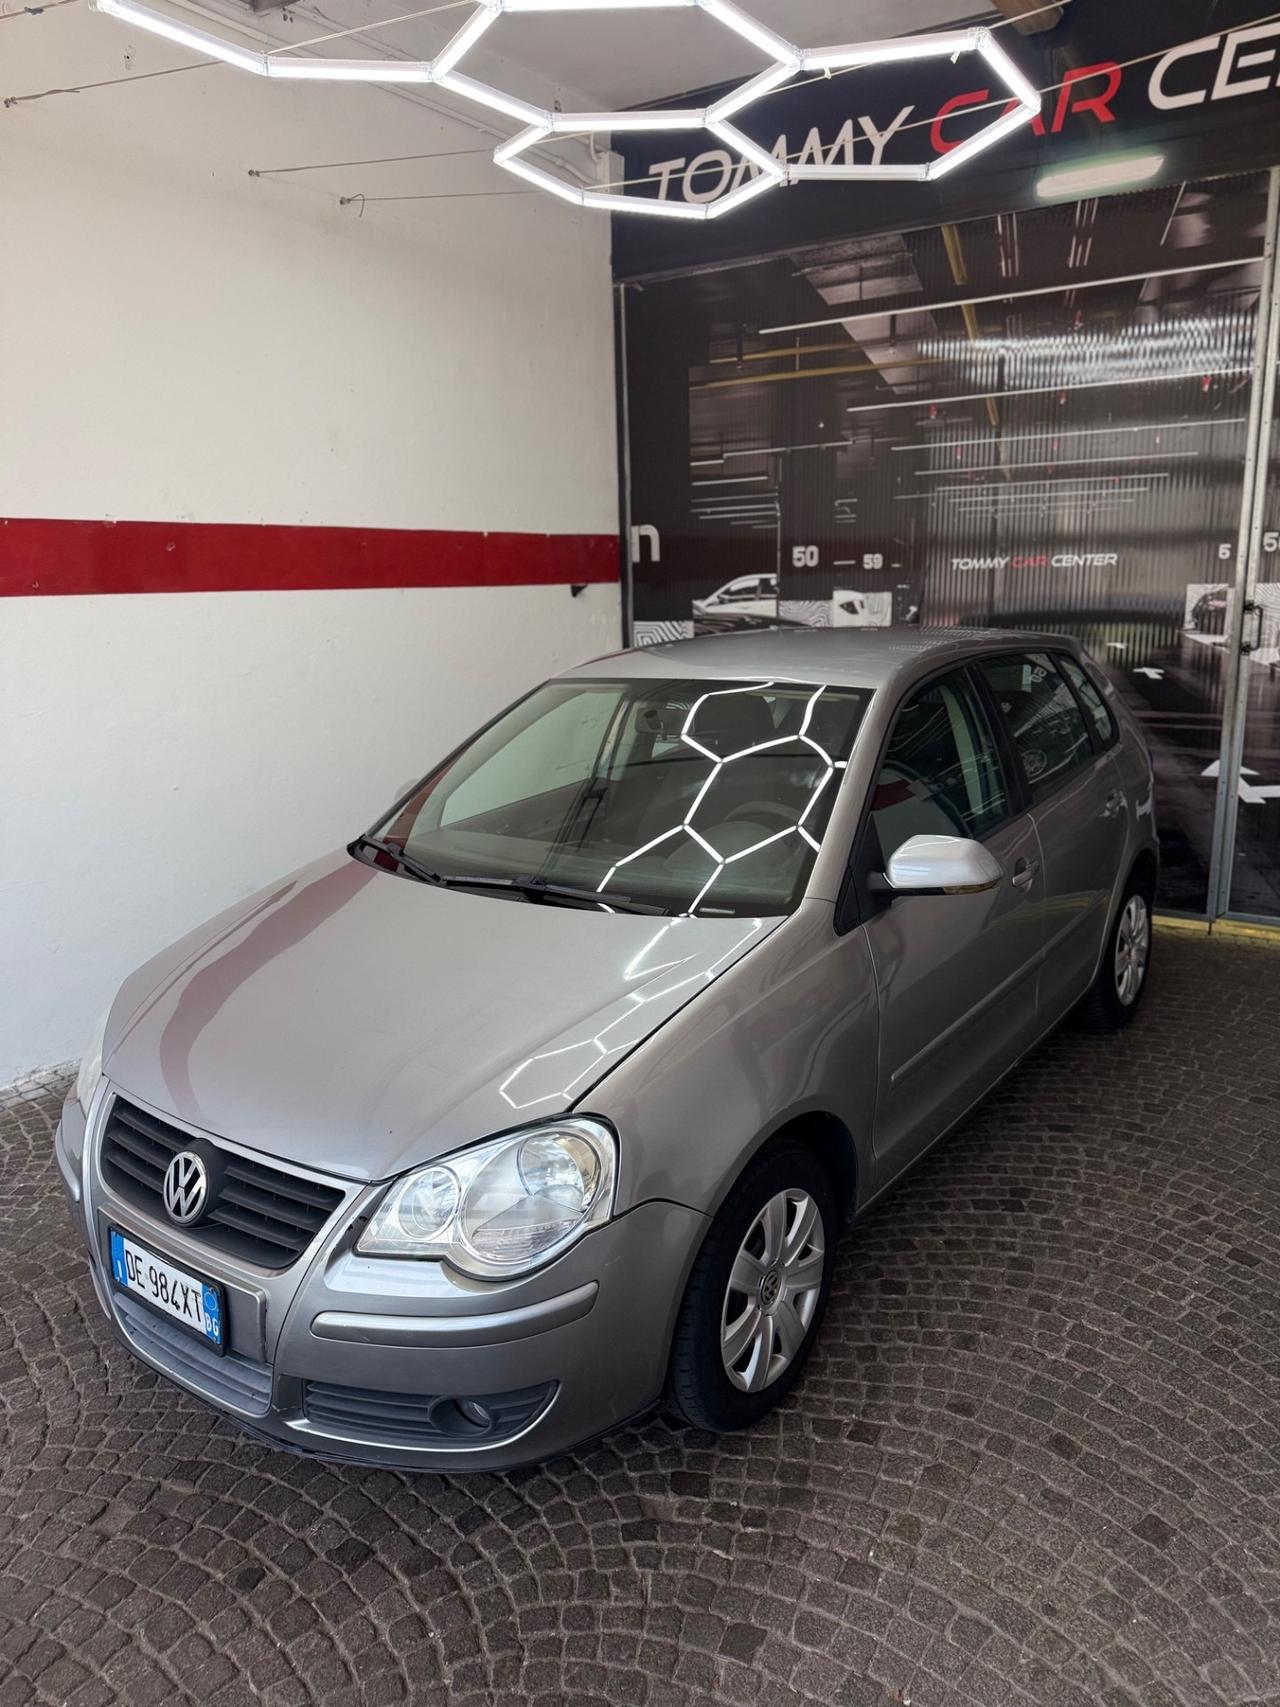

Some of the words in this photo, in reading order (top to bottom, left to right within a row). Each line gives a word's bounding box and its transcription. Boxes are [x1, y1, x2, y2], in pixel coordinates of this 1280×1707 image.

[792, 545, 819, 568] 50
[951, 555, 1010, 571] TOMMY
[1011, 554, 1048, 569] CAR
[1051, 552, 1118, 568] CENTER
[205, 1312, 220, 1337] BG
